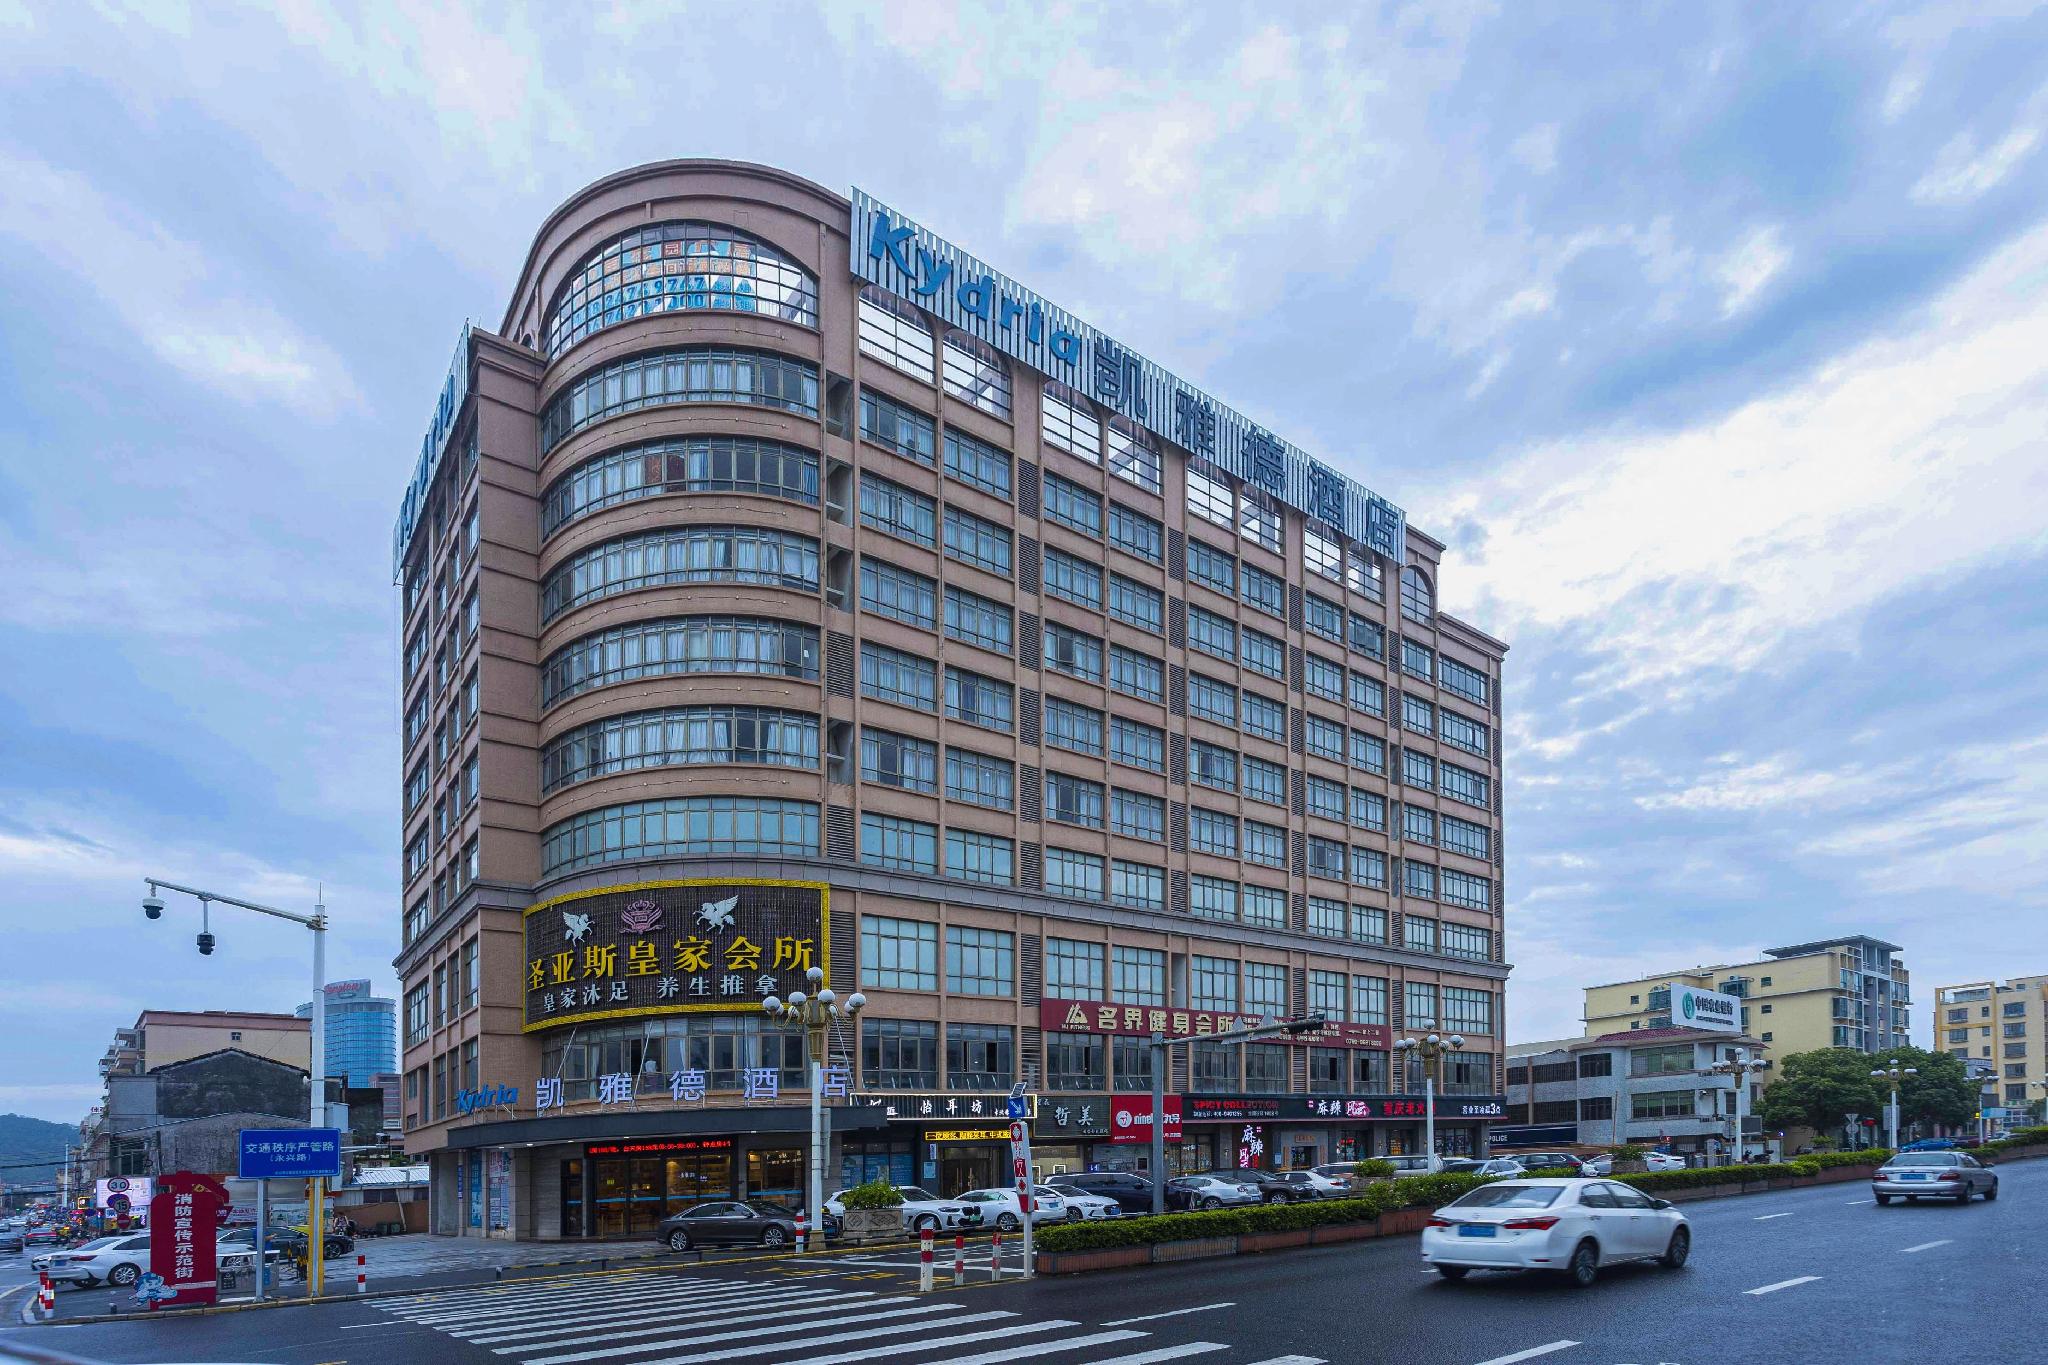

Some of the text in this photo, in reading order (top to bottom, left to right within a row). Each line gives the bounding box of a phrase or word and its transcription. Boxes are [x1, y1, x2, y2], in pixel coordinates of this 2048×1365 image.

[869, 210, 1399, 551] Kydria 凯雅德酒店
[527, 935, 814, 993] 圣亚斯皇家会所
[543, 974, 779, 1014] 皇家沐足 养生推拿
[1695, 996, 1733, 1016] 中国农业银行
[1098, 1005, 1234, 1036] 名界健身会所
[456, 1083, 519, 1115] Kydria
[536, 1067, 850, 1109] 凯雅德酒店
[1054, 1105, 1094, 1127] 哲美
[245, 1141, 335, 1154] 交通秩序严管路
[110, 1181, 126, 1189] 30
[116, 1201, 127, 1210] 15
[174, 1193, 194, 1279] 消防宣传示范街
